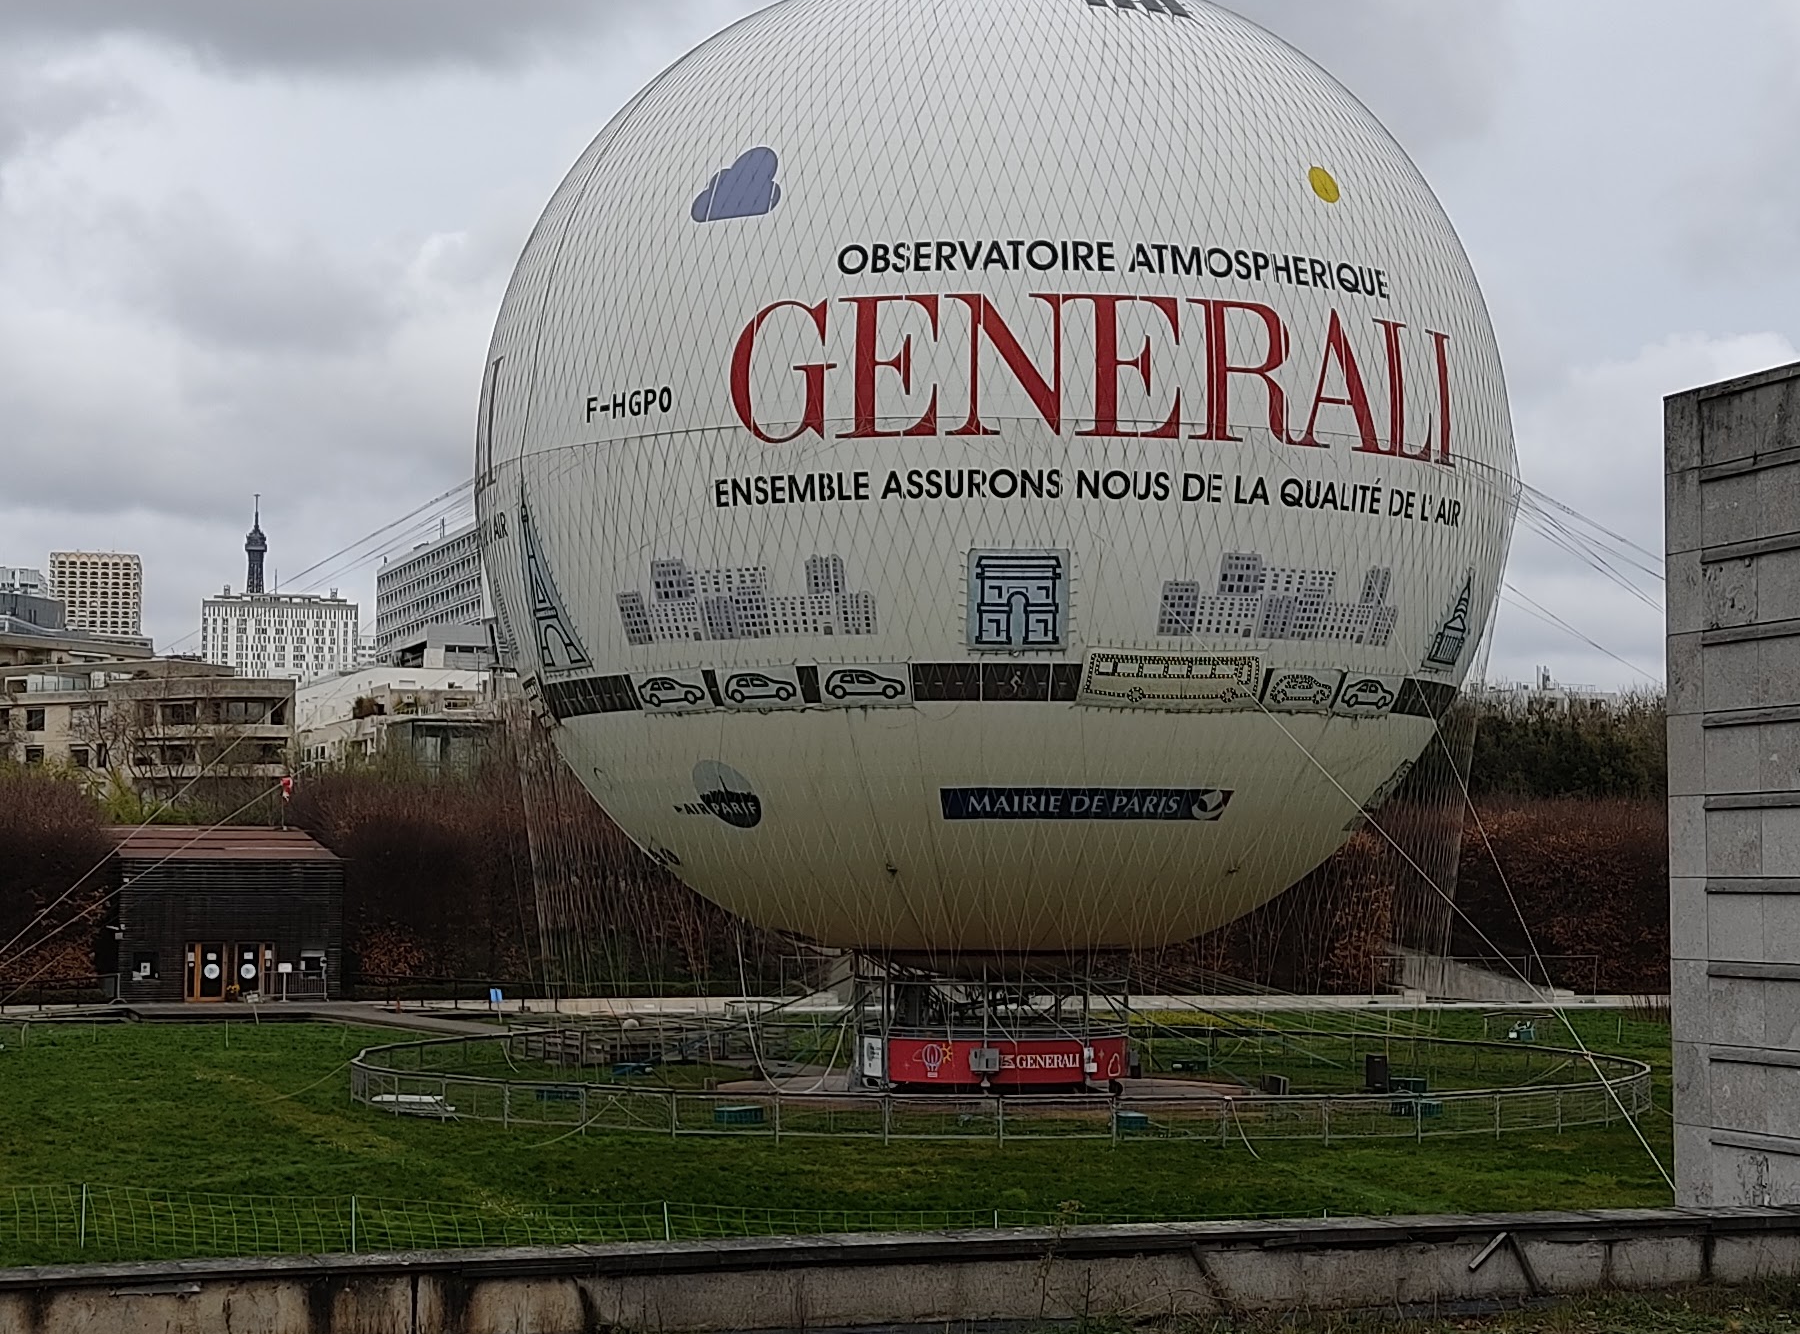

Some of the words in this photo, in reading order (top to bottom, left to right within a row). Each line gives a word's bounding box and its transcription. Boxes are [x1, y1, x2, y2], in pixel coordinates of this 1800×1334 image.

[836, 240, 1115, 275] OBSERVATOIRE
[1129, 243, 1389, 301] ATMOSPHERIQUE
[729, 293, 1456, 467] GENERALI
[714, 471, 870, 508] ENSEMBLE
[880, 468, 1064, 499] ASSURONS
[1076, 469, 1170, 501] NOUS
[1181, 473, 1222, 503] DE
[1234, 475, 1269, 505] LA
[1280, 478, 1381, 515] QUALITÉ
[1388, 488, 1415, 520] DE
[968, 795, 1061, 813] MAIRIE
[1070, 795, 1105, 813] DE
[1112, 795, 1181, 814] PARIS
[1016, 1054, 1080, 1069] GENERALI
